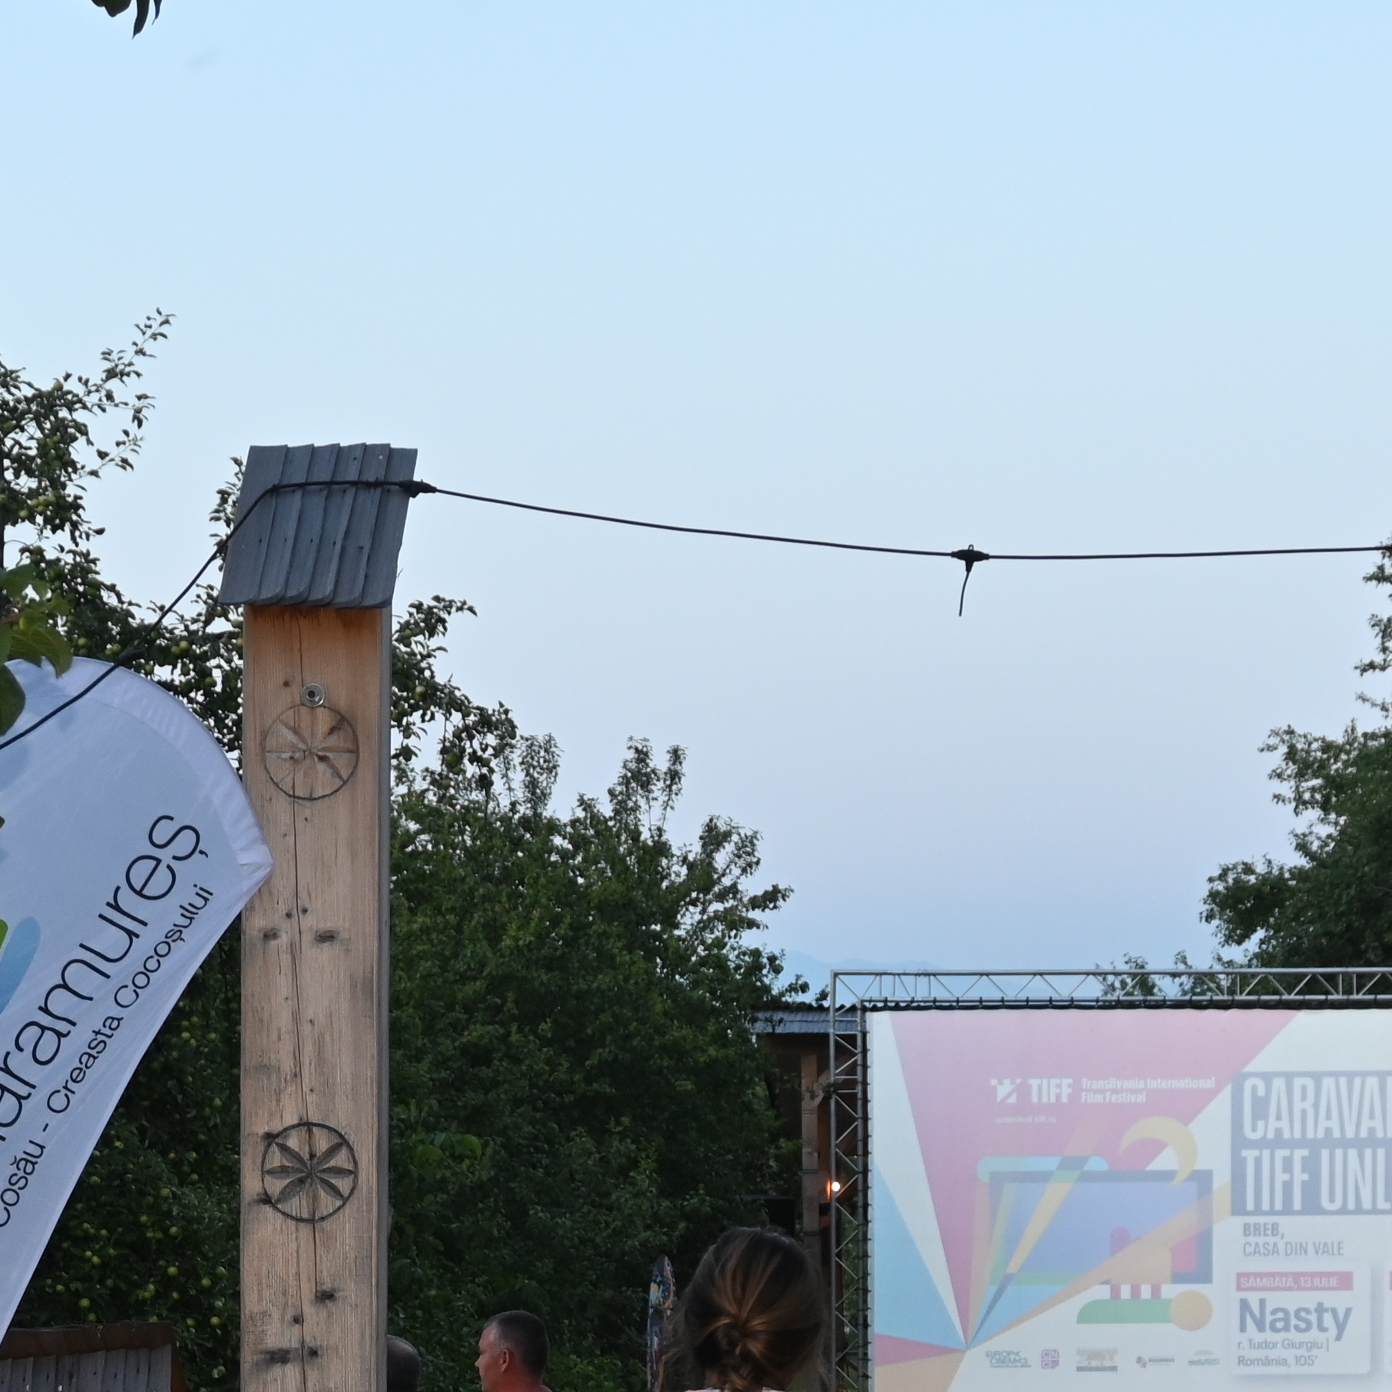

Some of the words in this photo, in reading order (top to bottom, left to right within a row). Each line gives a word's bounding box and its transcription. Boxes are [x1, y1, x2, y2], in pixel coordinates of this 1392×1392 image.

[46, 1015, 125, 1116] Creasta
[114, 883, 215, 1010] Cocoșului
[1028, 1078, 1073, 1104] TIFF
[1081, 1077, 1145, 1090] Transilvania
[1146, 1077, 1216, 1090] International
[1081, 1091, 1104, 1104] Film
[1105, 1090, 1147, 1104] Festival
[1241, 1148, 1310, 1212] TIFF
[1243, 1222, 1285, 1239] BREB,
[1243, 1241, 1280, 1257] CASA
[1285, 1241, 1306, 1257] DIN
[1313, 1241, 1345, 1257] VALE
[1300, 1276, 1312, 1288] 13
[1313, 1276, 1340, 1288] IULIE
[1239, 1297, 1354, 1343] Nasty
[1237, 1340, 1245, 1350] r.
[1248, 1338, 1280, 1351] Tudor
[1281, 1338, 1323, 1353] Giurgiu
[1238, 1354, 1292, 1369] România,
